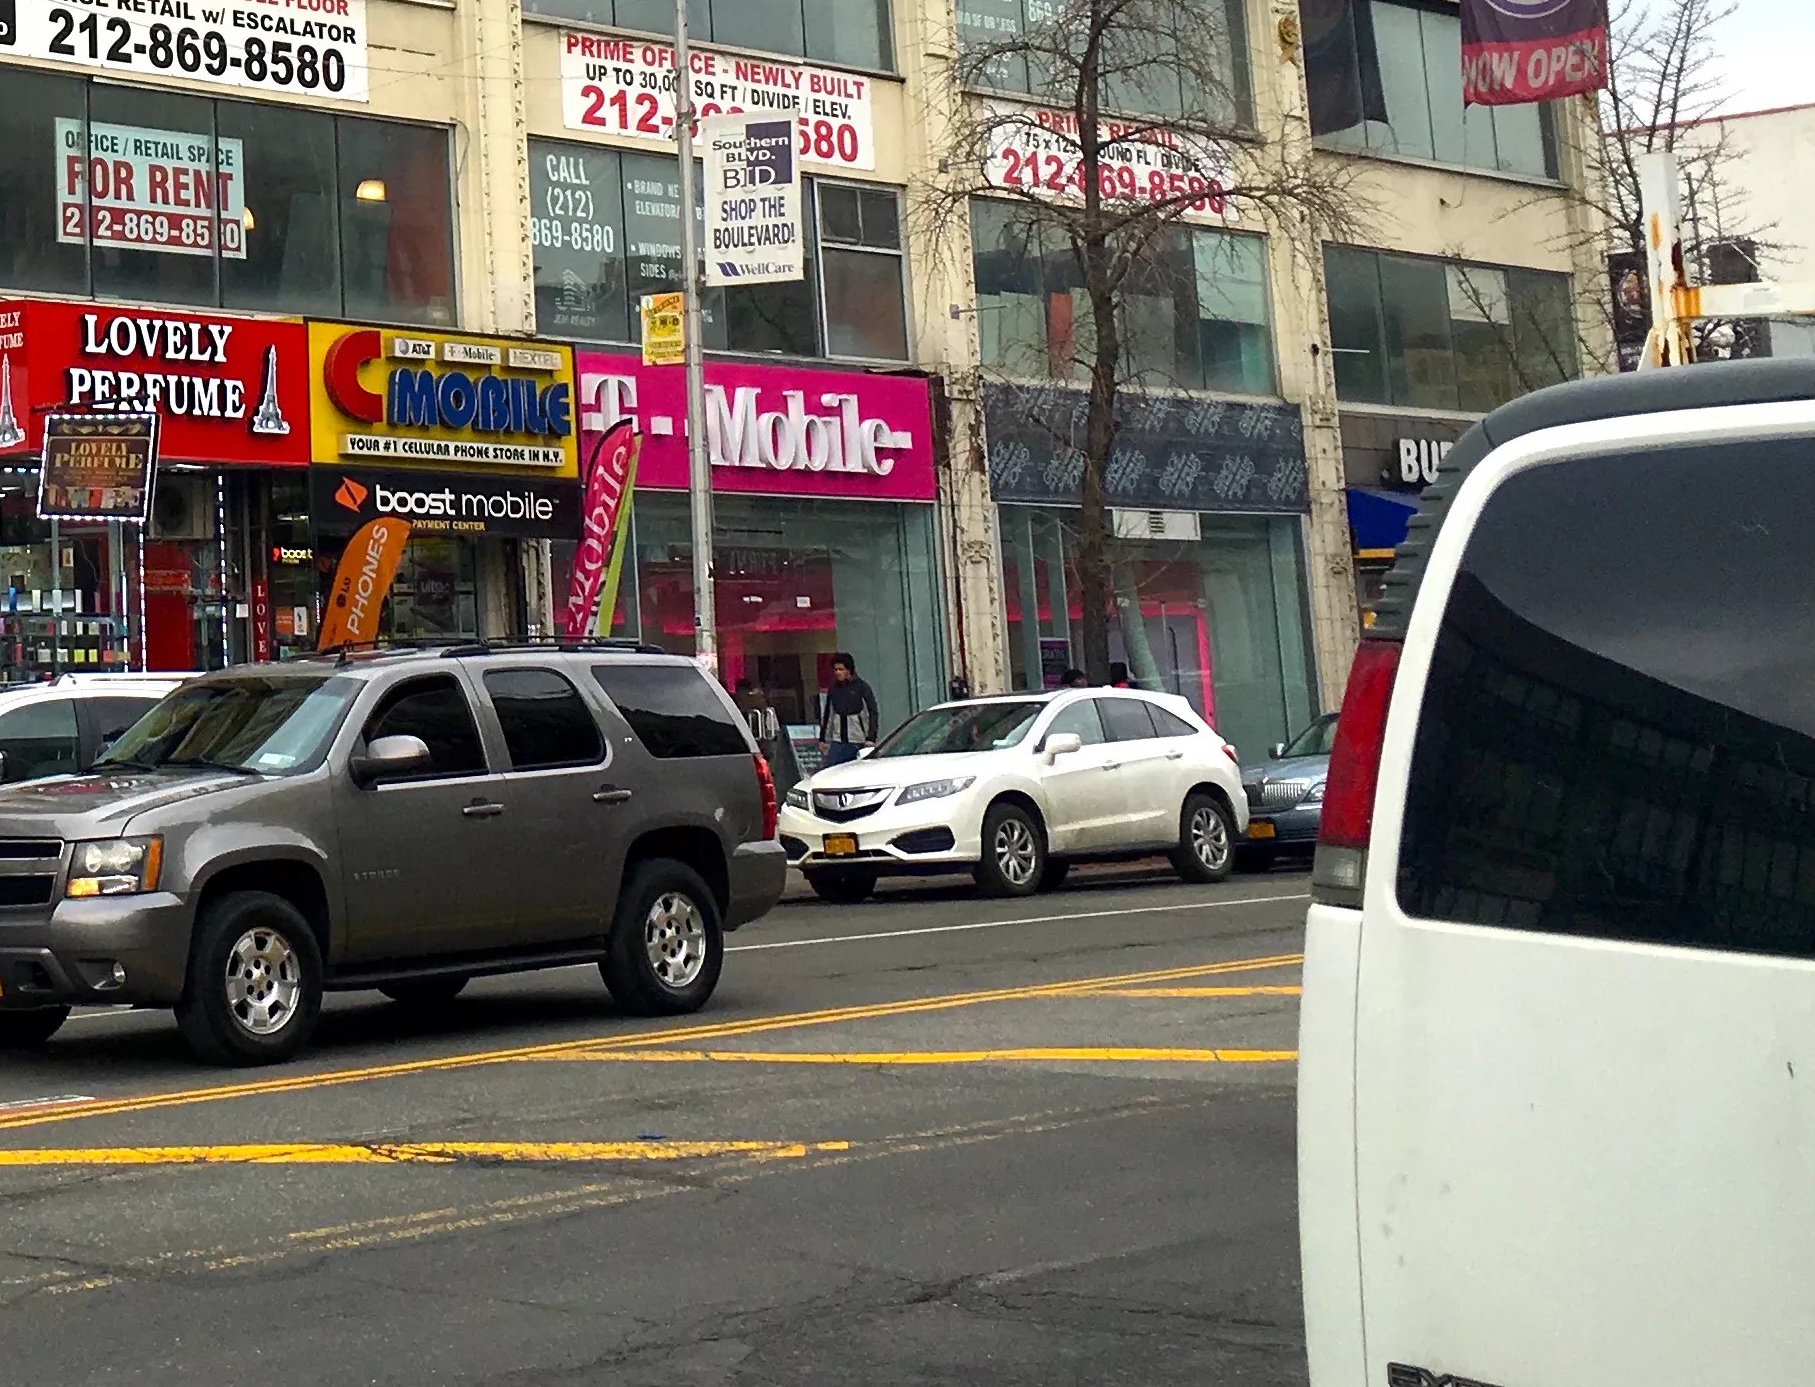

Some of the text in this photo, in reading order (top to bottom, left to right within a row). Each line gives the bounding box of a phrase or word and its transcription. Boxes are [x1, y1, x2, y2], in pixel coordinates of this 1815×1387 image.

[201, 7, 226, 26] w/
[232, 9, 357, 45] ESCALATOR
[48, 8, 346, 93] 212-869-8580
[1527, 36, 1601, 89] OPEN
[566, 34, 635, 64] PRIME
[734, 61, 803, 90] NEWLY
[809, 73, 865, 101] BUILT
[585, 62, 607, 81] UP
[612, 66, 634, 87] TO
[694, 79, 716, 99] SQ
[720, 84, 737, 103] FT
[750, 88, 800, 111] DIVIDE
[813, 98, 852, 121] ELEV.
[133, 138, 183, 161] RETAIL
[712, 136, 789, 151] Southern
[725, 150, 776, 163] BLVD.
[1136, 152, 1151, 166] FL
[66, 155, 234, 212] FOR RENT
[546, 154, 590, 186] CALL
[723, 165, 776, 189] BID
[546, 186, 594, 220] (212)
[634, 180, 680, 198] BRAND NE
[721, 197, 756, 222] SHOP
[759, 195, 786, 219] THE
[65, 207, 240, 249] 22-869-850
[531, 217, 614, 253] 869-8580
[713, 222, 796, 249] BOULEVARD!
[640, 262, 667, 279] SIDES
[739, 261, 795, 276] WellCare
[84, 313, 233, 363] LOVELY
[411, 342, 432, 356] AT&T
[69, 367, 246, 419] PERFUME
[323, 330, 384, 424] C
[388, 367, 573, 437] MOBILE
[53, 453, 143, 470] PERFUME
[70, 441, 128, 455] LOVELY
[349, 437, 564, 463] YOUR #1 CELLULAR PHONE STORE IN N.Y.
[375, 483, 553, 520] boost mobile
[412, 518, 486, 532] PAYMENT CENTER
[347, 524, 388, 636] PHONES
